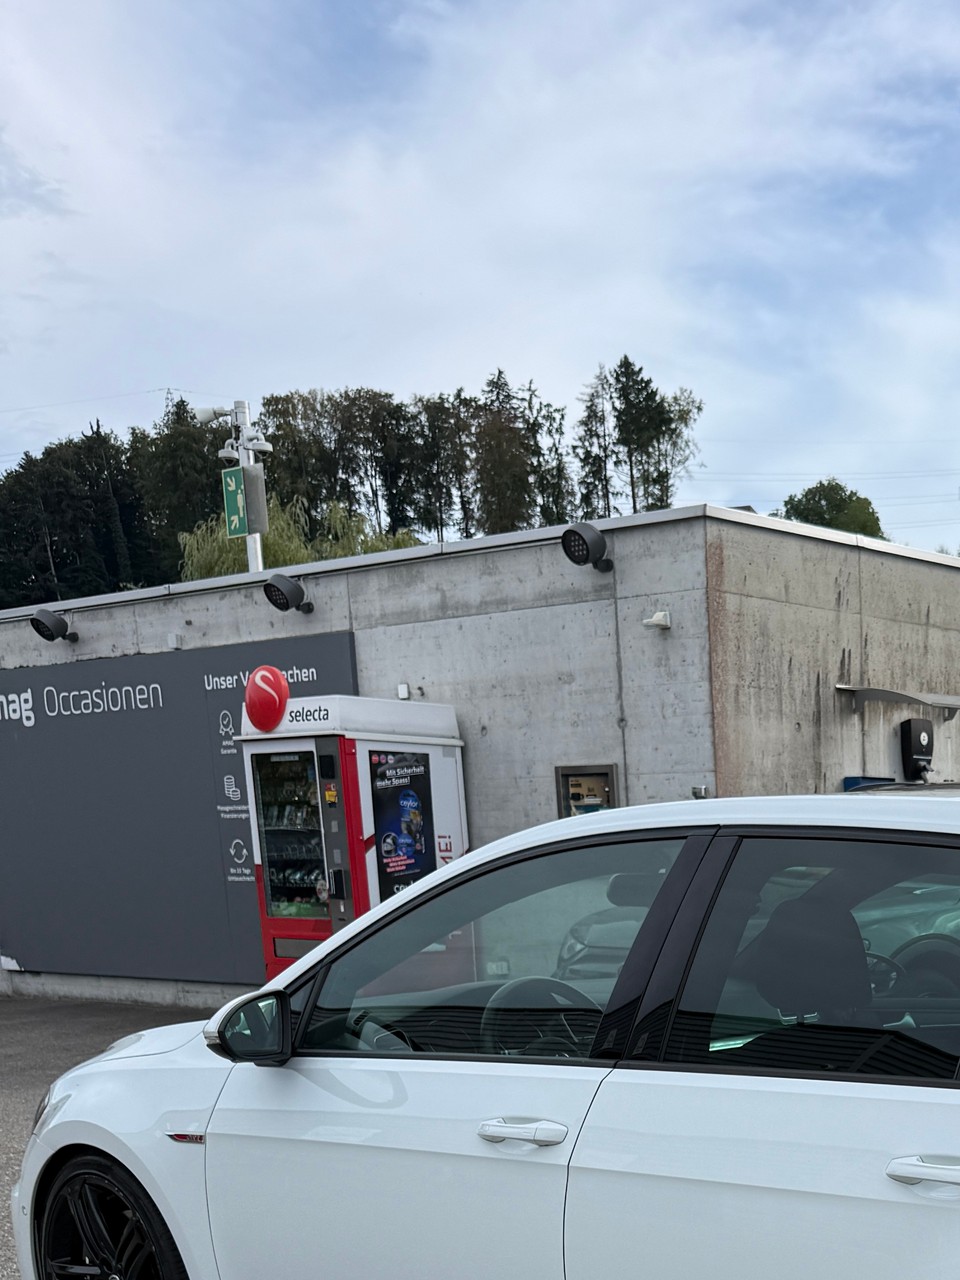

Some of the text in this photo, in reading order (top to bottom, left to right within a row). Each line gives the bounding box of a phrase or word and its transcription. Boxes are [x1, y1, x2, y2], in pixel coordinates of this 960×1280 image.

[204, 674, 238, 690] Unser
[44, 681, 163, 716] Occasionen
[289, 706, 329, 723] selecta
[386, 766, 425, 777] Mit Sicherheit
[376, 778, 391, 787] mehr
